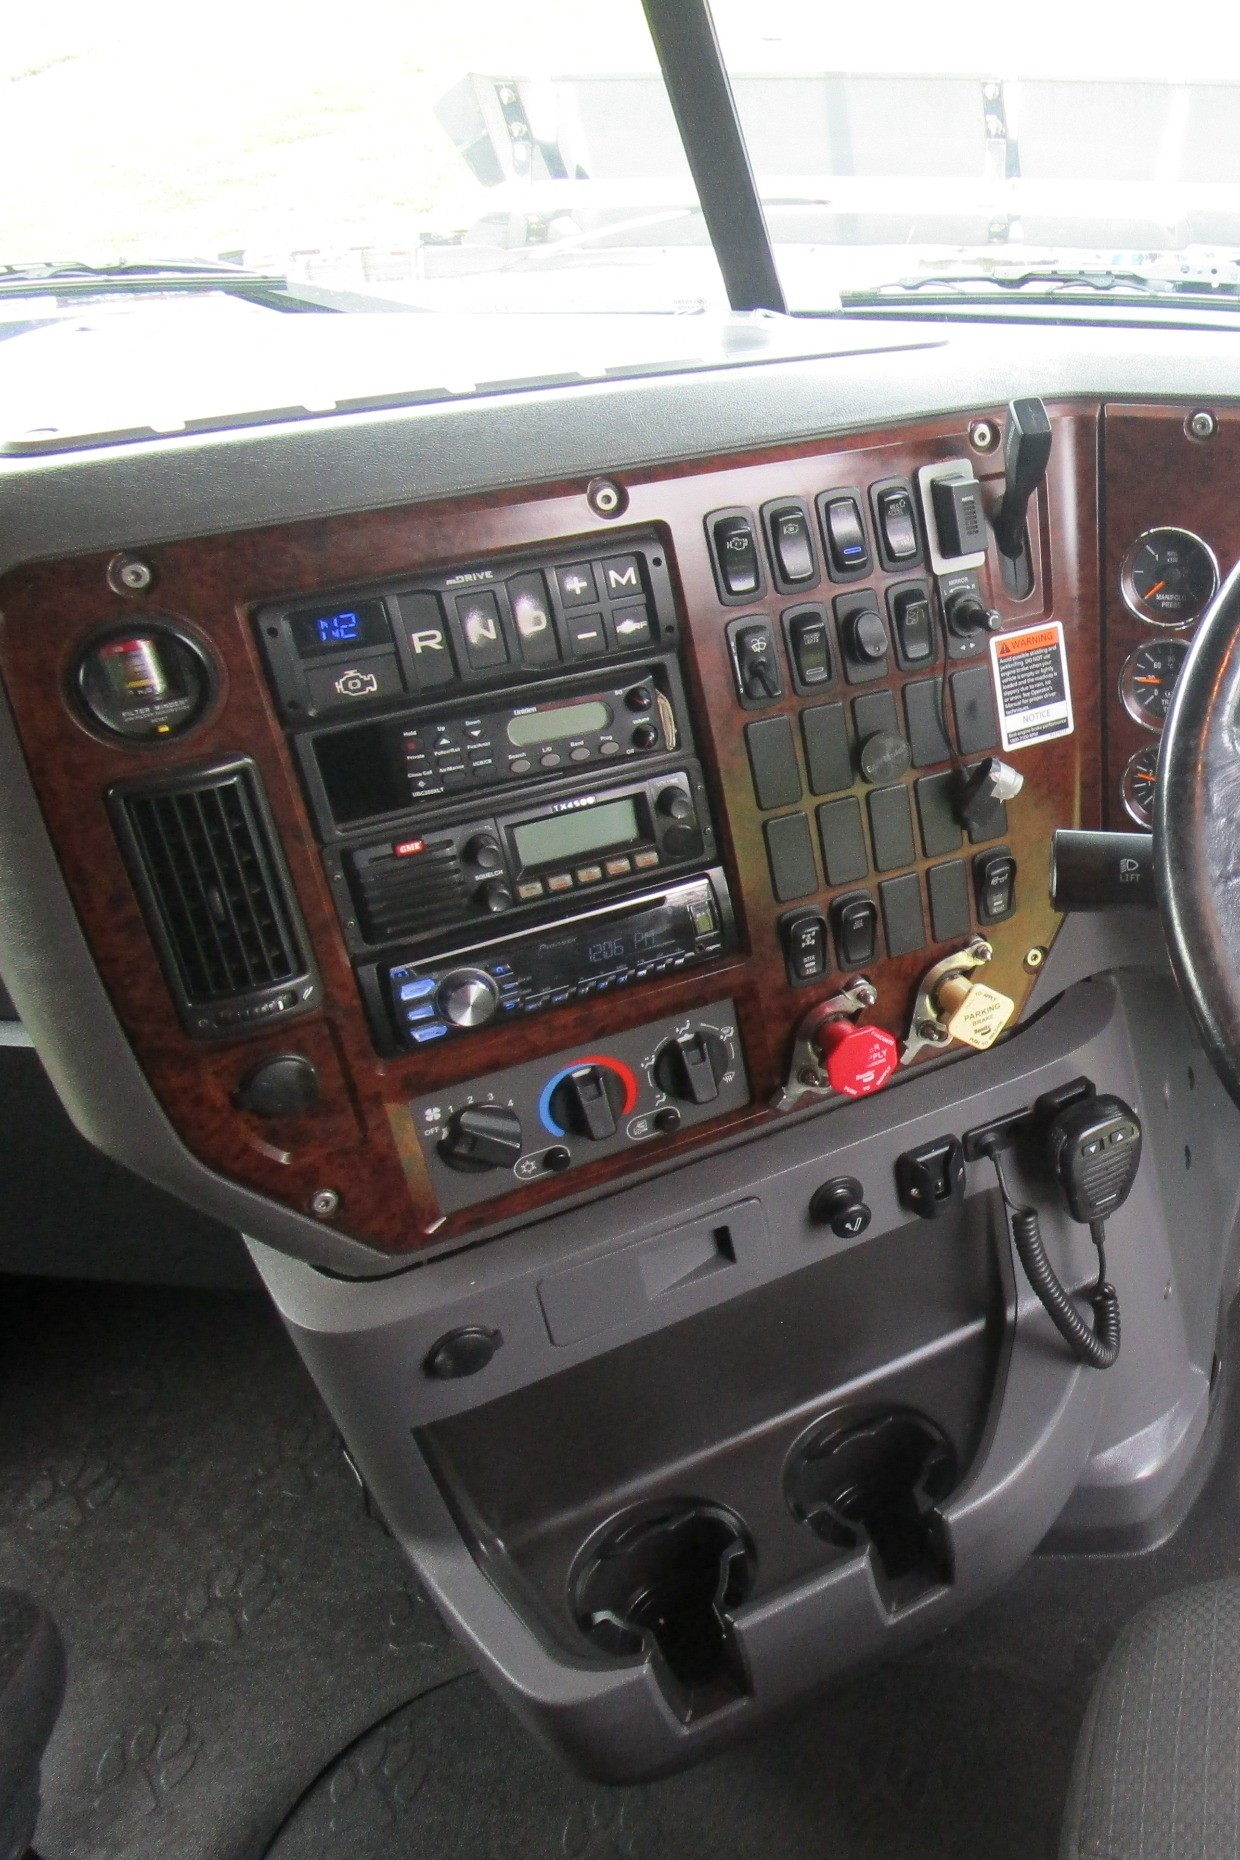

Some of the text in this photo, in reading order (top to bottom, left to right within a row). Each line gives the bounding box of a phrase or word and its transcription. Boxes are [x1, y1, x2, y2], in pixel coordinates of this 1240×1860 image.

[608, 566, 637, 588] M
[948, 577, 969, 586] MIRROR
[317, 612, 358, 641] N2
[518, 609, 548, 637] D
[466, 614, 497, 644] N
[412, 630, 444, 654] R
[1010, 632, 1054, 650] WARNING
[1013, 652, 1029, 662] possible
[1003, 682, 1018, 690] loaded
[513, 706, 538, 716] Uniden
[1023, 708, 1051, 724] NOTICE
[632, 716, 650, 725] Volume
[570, 740, 584, 748] Band
[508, 752, 527, 760] Search
[552, 796, 596, 813] TX4500
[400, 842, 420, 854] GME
[474, 869, 504, 882] SQUELCH
[1120, 874, 1140, 882] LIFT
[983, 992, 997, 1002] APPLY
[964, 1002, 1000, 1022] PARKING
[972, 1014, 994, 1026] BRAKE
[968, 1036, 980, 1046] PUSH
[844, 1085, 858, 1096] PUSH
[466, 1096, 474, 1104] 2
[488, 1092, 494, 1100] 3
[508, 1098, 514, 1107] 4
[448, 1105, 454, 1113] 1
[424, 1126, 440, 1136] OFF
